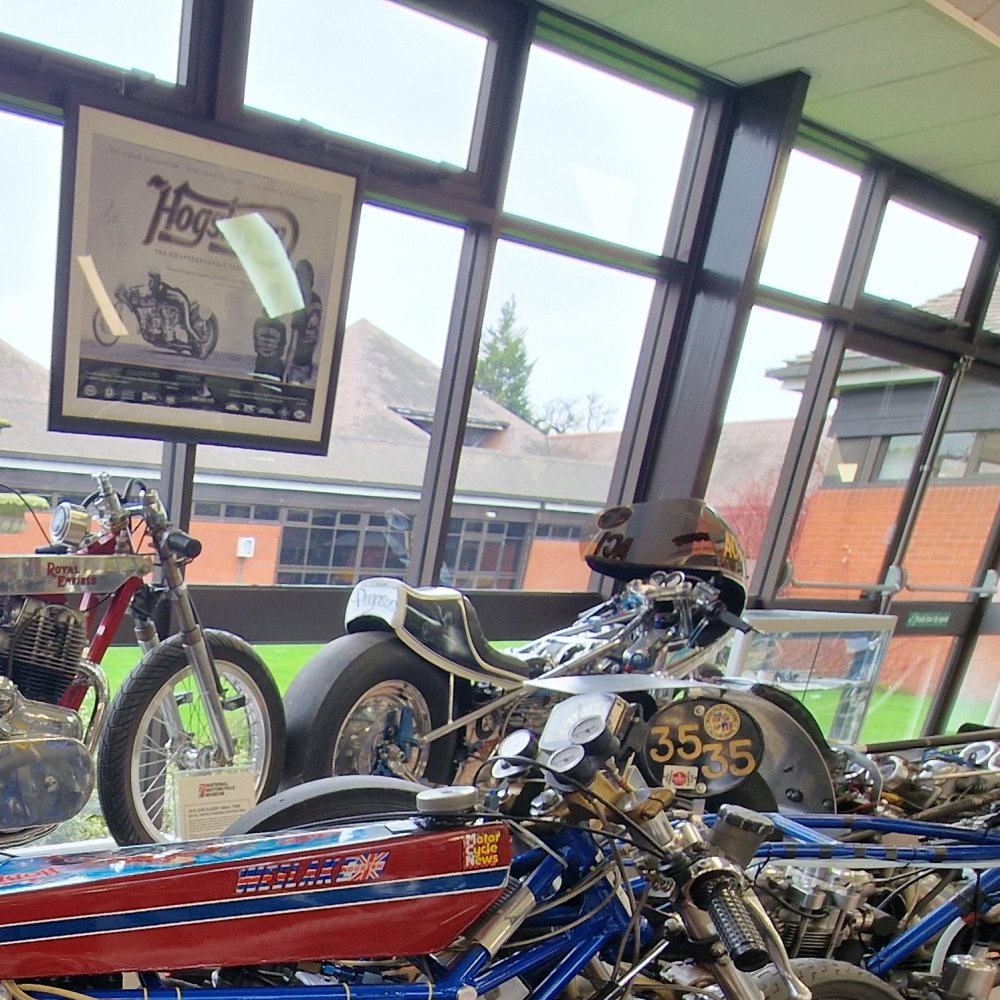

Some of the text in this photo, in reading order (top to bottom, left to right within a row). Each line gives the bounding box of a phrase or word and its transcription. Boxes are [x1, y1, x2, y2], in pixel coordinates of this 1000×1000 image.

[47, 562, 79, 577] ROYAL
[57, 575, 97, 587] ENFIELD
[650, 724, 702, 763] 35
[701, 739, 756, 779] 35
[465, 830, 501, 845] Motor
[465, 843, 498, 857] Cycle
[465, 854, 498, 867] News
